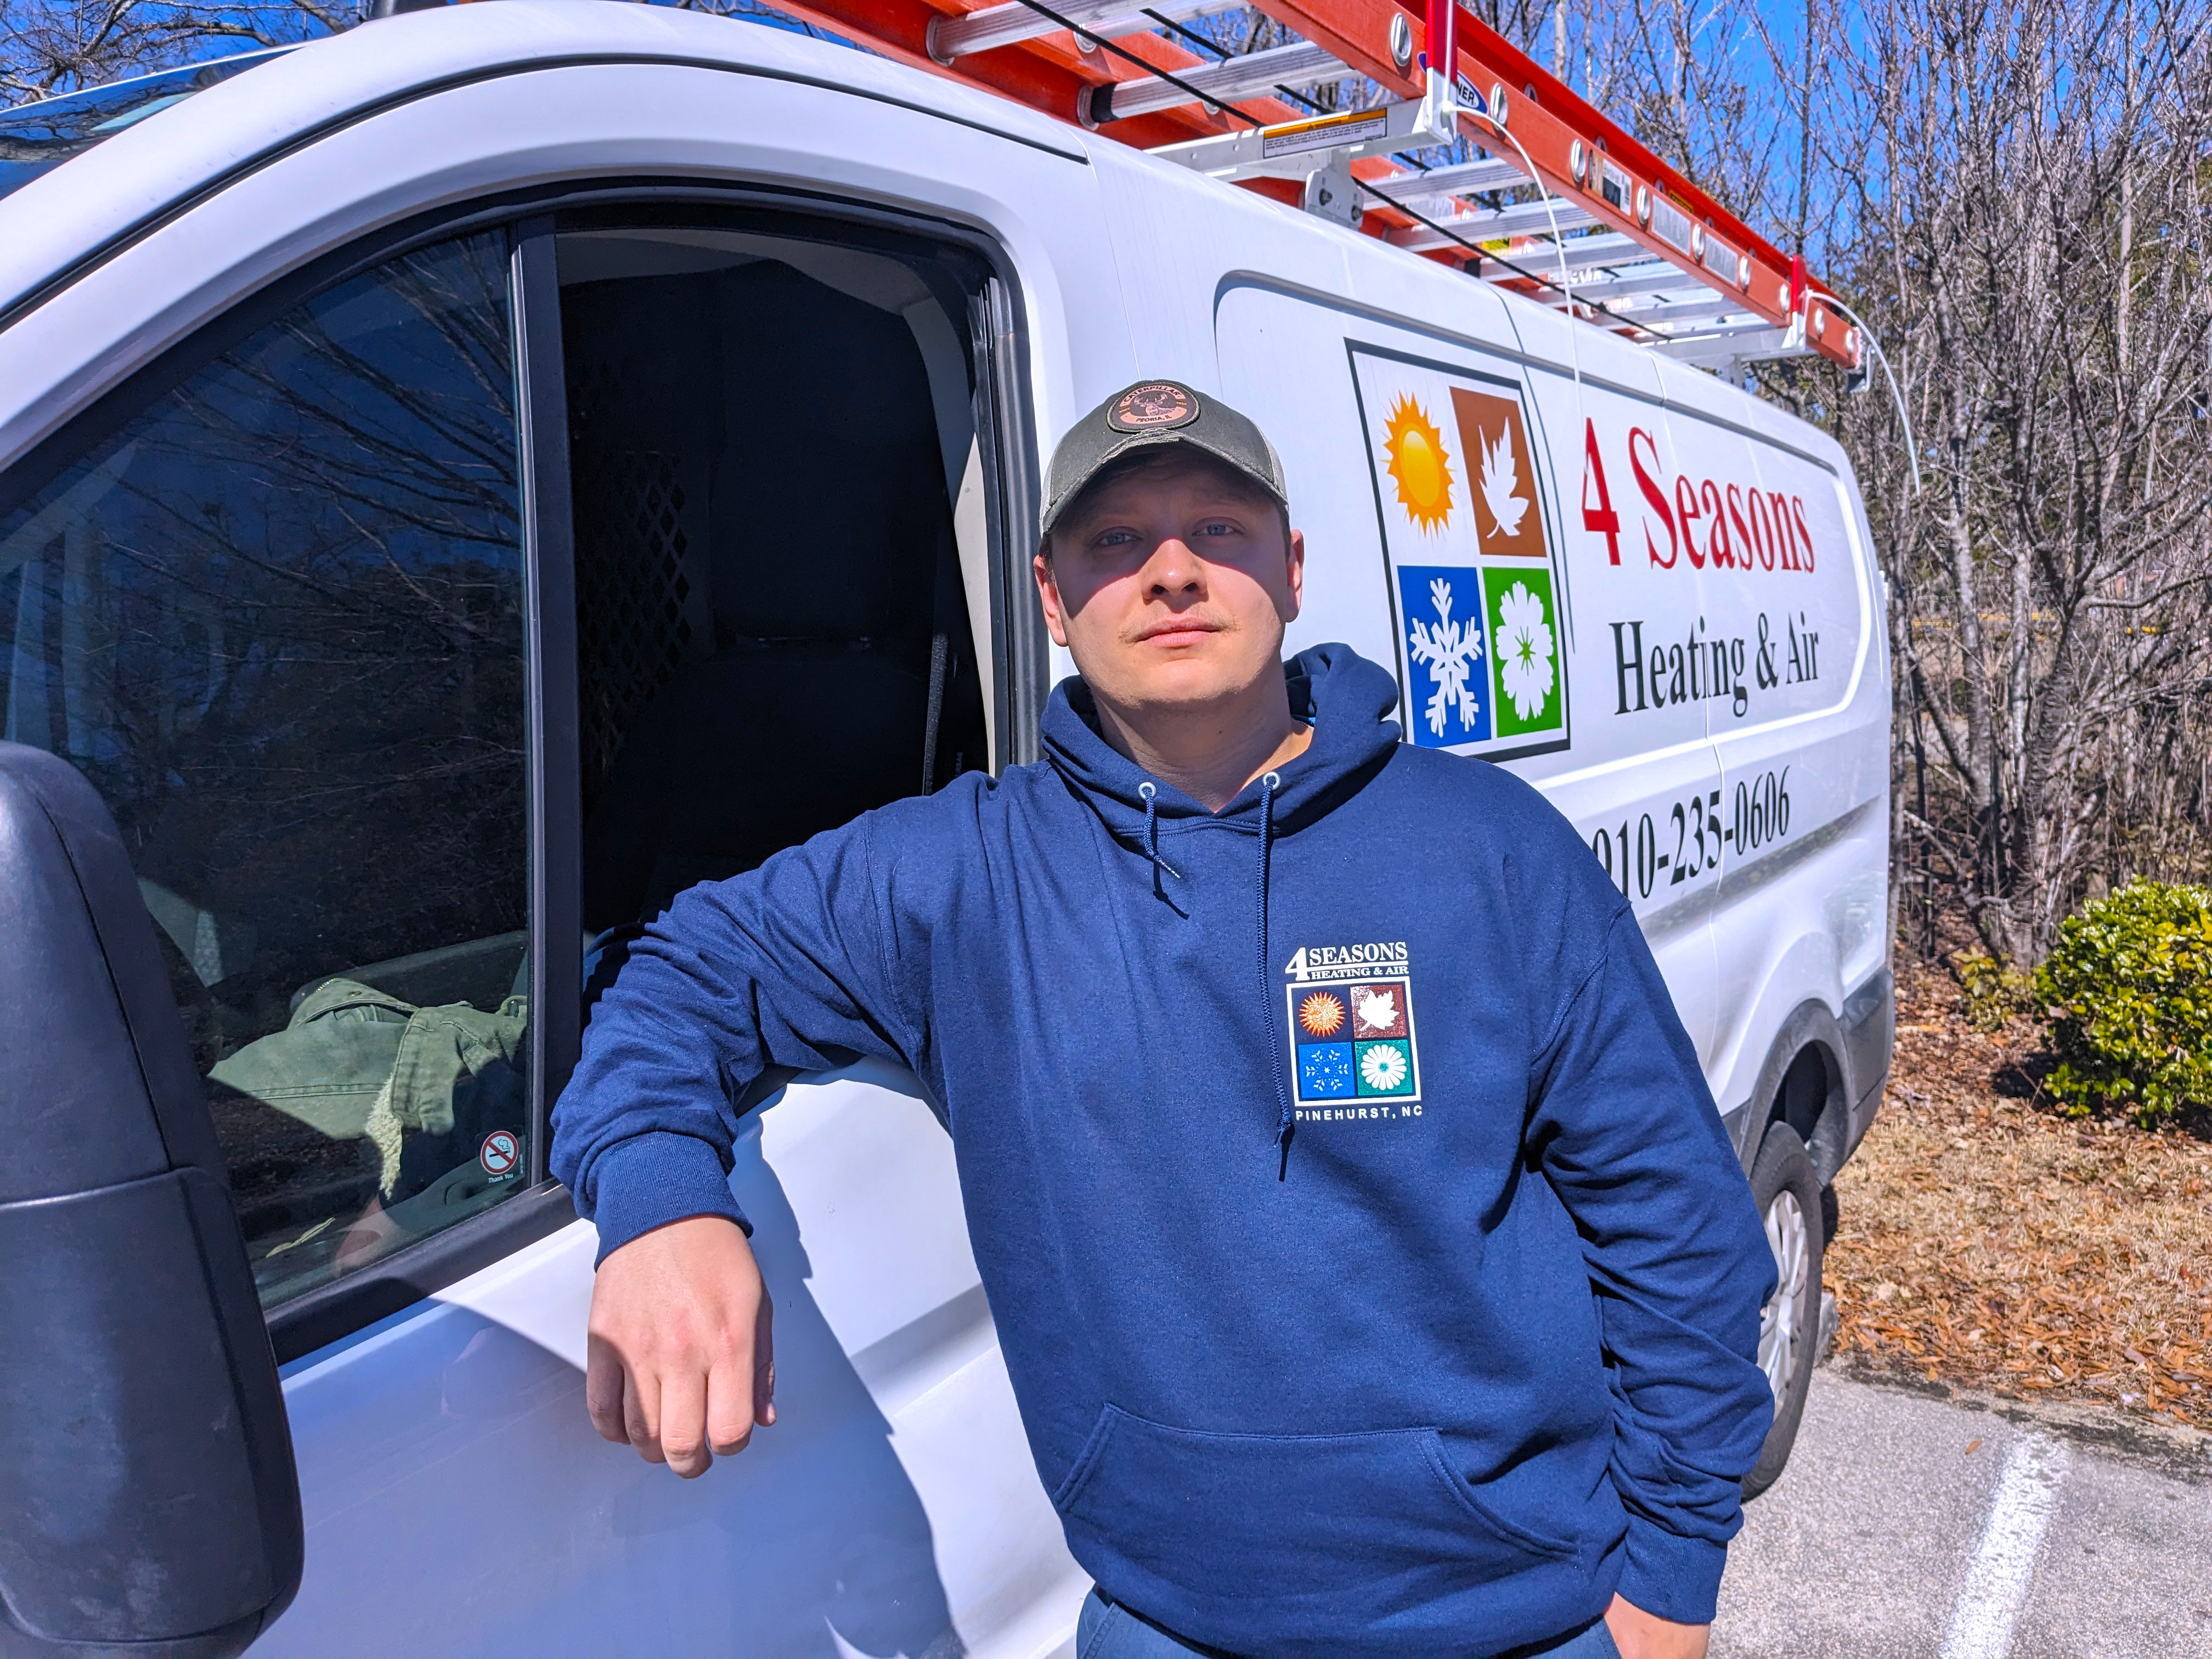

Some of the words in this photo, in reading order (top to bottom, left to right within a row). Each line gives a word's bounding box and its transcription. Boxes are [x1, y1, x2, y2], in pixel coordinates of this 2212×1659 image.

[1124, 386, 1182, 402] CATERPILLAR
[1582, 417, 1621, 566] 4
[1629, 427, 1815, 573] Seasons
[1610, 616, 1748, 718] Heating
[1757, 612, 1778, 690] &
[1786, 611, 1820, 684] Air
[1285, 947, 1310, 981] 4
[1310, 941, 1408, 966] SEASONS
[1311, 967, 1372, 980] HEATING
[1373, 967, 1384, 975] &
[1385, 966, 1409, 975] AIR
[1296, 1108, 1396, 1121] PINEHURST,
[1402, 1105, 1423, 1116] NC
